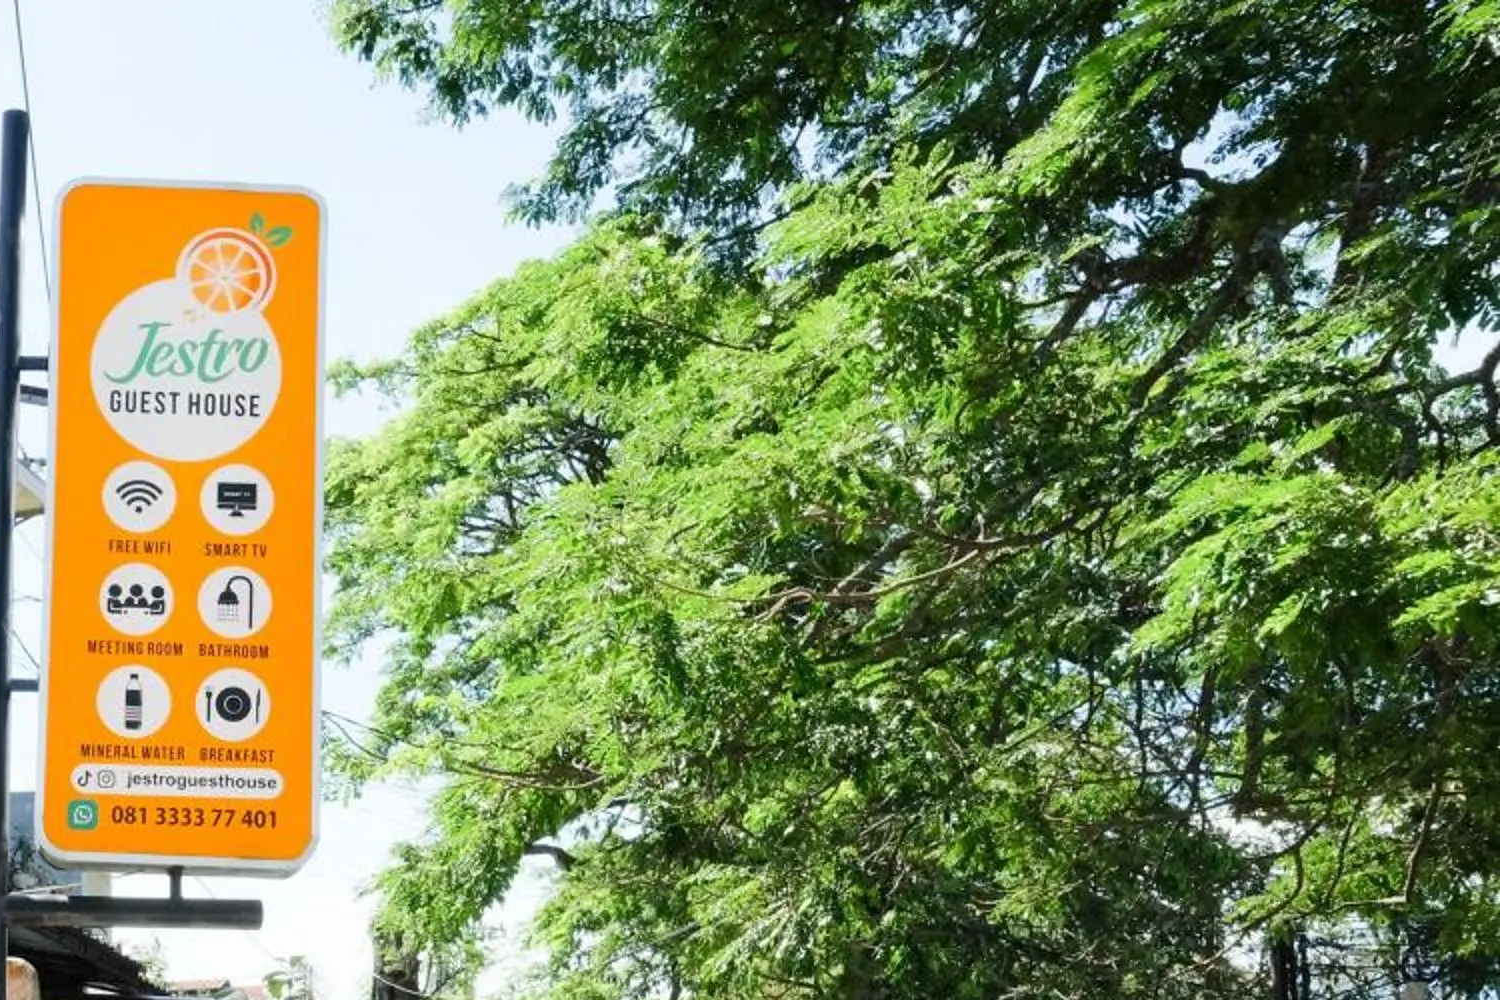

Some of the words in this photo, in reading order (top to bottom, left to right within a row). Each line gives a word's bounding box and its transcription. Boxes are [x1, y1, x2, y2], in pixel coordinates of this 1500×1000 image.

[102, 321, 269, 385] Jestro
[109, 389, 181, 415] GUEST
[187, 392, 261, 418] HOUSE
[109, 539, 140, 554] FREE
[143, 540, 171, 555] WIFI
[204, 542, 248, 557] SMART
[251, 543, 267, 558] TV
[87, 639, 143, 656] MEETING
[147, 641, 184, 657] ROOM
[198, 643, 270, 659] BATHROOM
[80, 743, 137, 760] MINERAL
[141, 745, 186, 761] WATER
[199, 747, 275, 763] BREAKFAST
[125, 769, 277, 791] jestroguesthouse
[111, 805, 148, 825] 081
[155, 806, 205, 827] 3333
[211, 808, 235, 828] 77
[241, 809, 277, 830] 401
